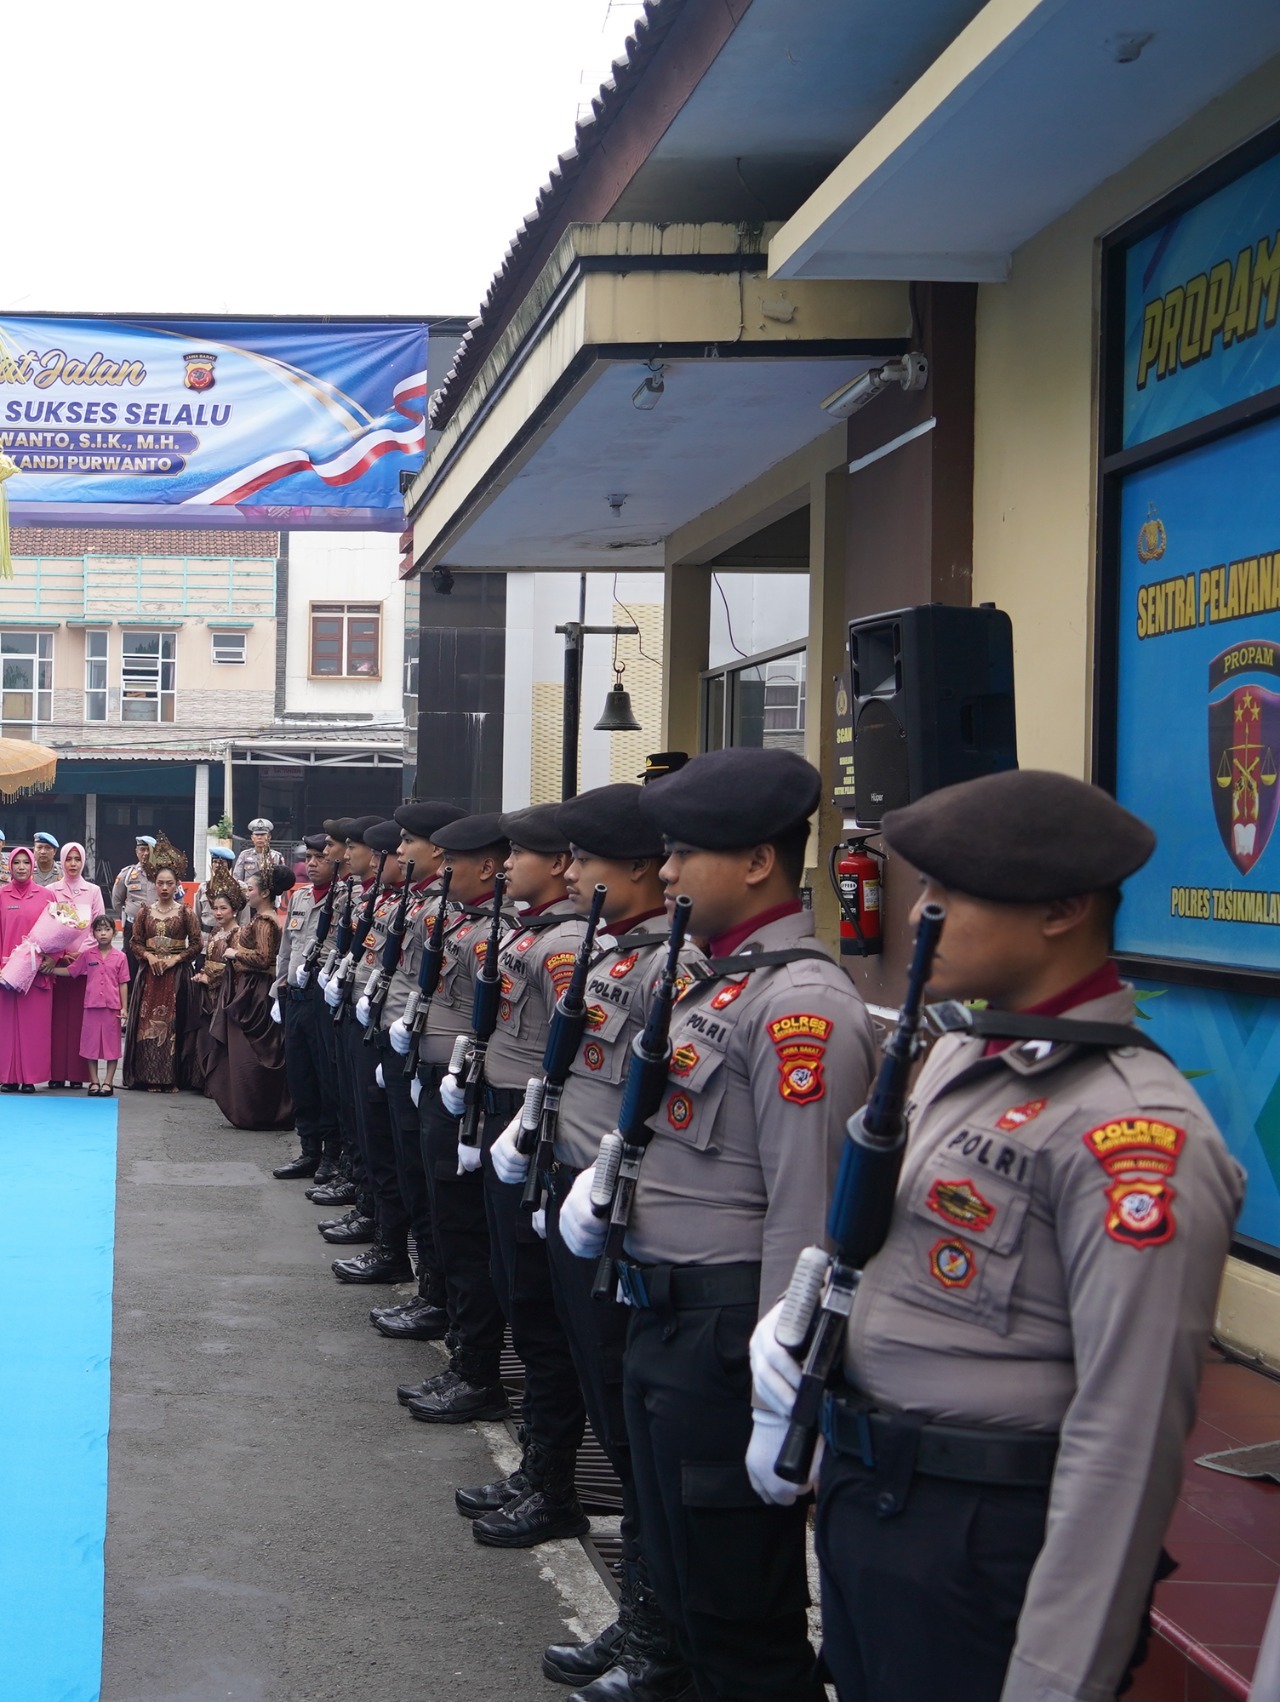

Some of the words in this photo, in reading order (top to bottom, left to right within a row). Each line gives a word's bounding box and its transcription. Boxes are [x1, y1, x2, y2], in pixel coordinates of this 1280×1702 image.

[34, 349, 147, 389] Jalan
[5, 400, 119, 424] SUKSES
[125, 403, 231, 426] SELALU
[137, 436, 179, 449] M.H.
[20, 454, 64, 469] ANDI
[68, 457, 172, 471] PURWANTO
[1137, 569, 1197, 641] SENTRA
[1224, 646, 1274, 673] PROPAM
[1171, 886, 1210, 919] POLRES
[500, 952, 526, 975] POLRI
[588, 979, 630, 1005] POLRI
[686, 1013, 727, 1043] POLRI
[772, 1016, 826, 1032] POLRES
[1092, 1120, 1177, 1144] POLRES
[948, 1130, 1029, 1182] POLRI
